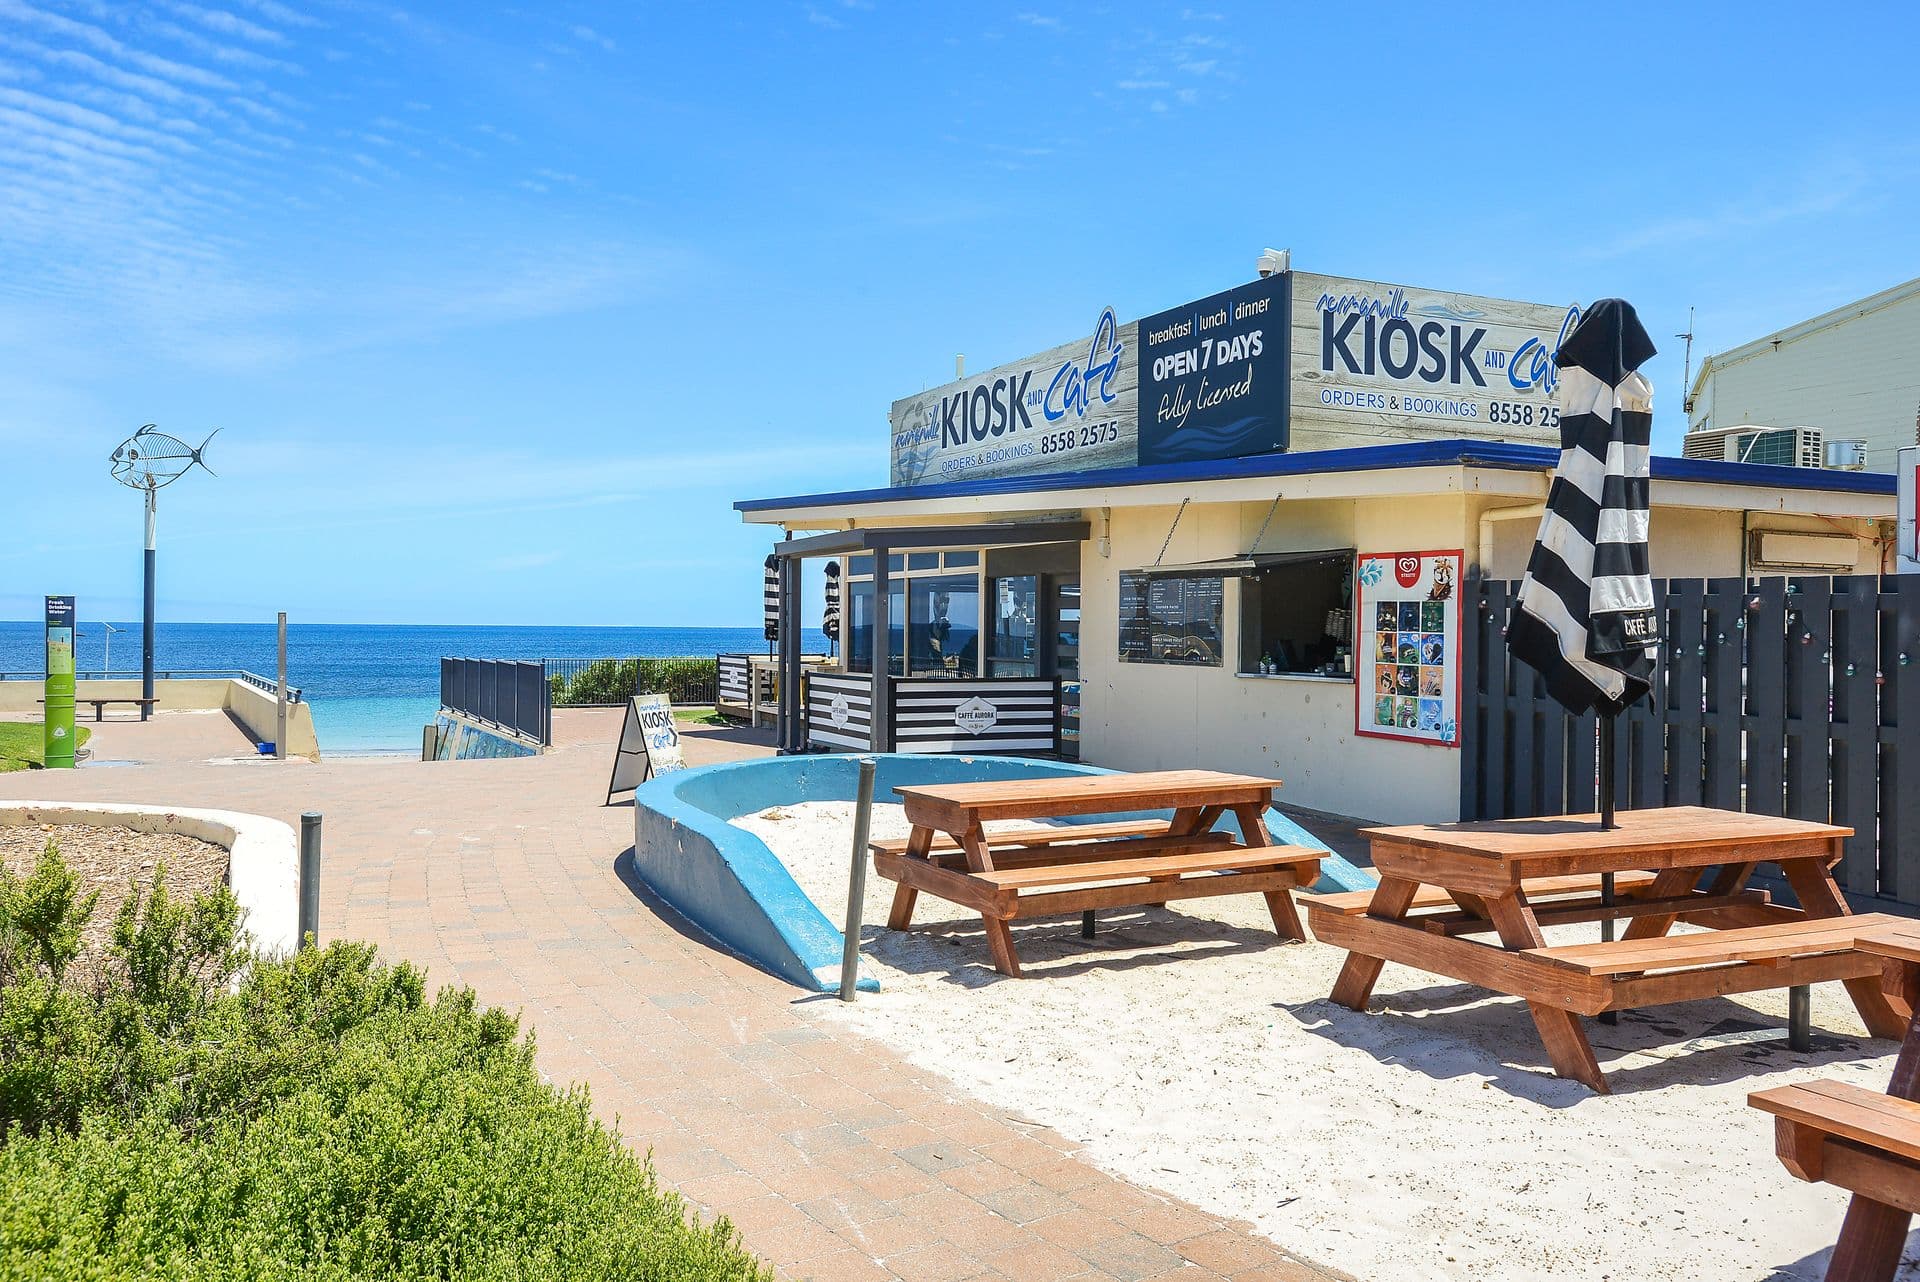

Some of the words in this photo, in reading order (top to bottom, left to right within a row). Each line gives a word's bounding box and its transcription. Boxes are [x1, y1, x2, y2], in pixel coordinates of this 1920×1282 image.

[1149, 319, 1192, 345] breakfast
[1200, 309, 1227, 331] lunch
[1235, 297, 1271, 320] dinner
[1153, 348, 1198, 382] OPEN
[1201, 339, 1214, 370] 7
[1217, 330, 1263, 366] DAYS
[1322, 309, 1488, 387] KIOSK
[1485, 350, 1505, 369] AND
[1507, 305, 1582, 394] Caf
[941, 370, 1033, 449] KIOSK
[1027, 388, 1043, 408] AND
[1043, 310, 1122, 421] Café
[1158, 383, 1192, 429] fully
[1197, 363, 1253, 410] licensed
[1321, 389, 1385, 409] ORDERS
[1389, 395, 1400, 410] &
[1404, 397, 1478, 417] BOOKINGS
[1489, 402, 1533, 426] 8558
[1540, 406, 1560, 428] 25
[941, 455, 976, 472] ORDERS
[978, 453, 984, 465] &
[986, 442, 1033, 463] BOOKINGS
[1041, 430, 1075, 455] 8558
[1080, 420, 1118, 447] 2575
[641, 710, 673, 729] KIOSK
[975, 711, 994, 719] AURORA
